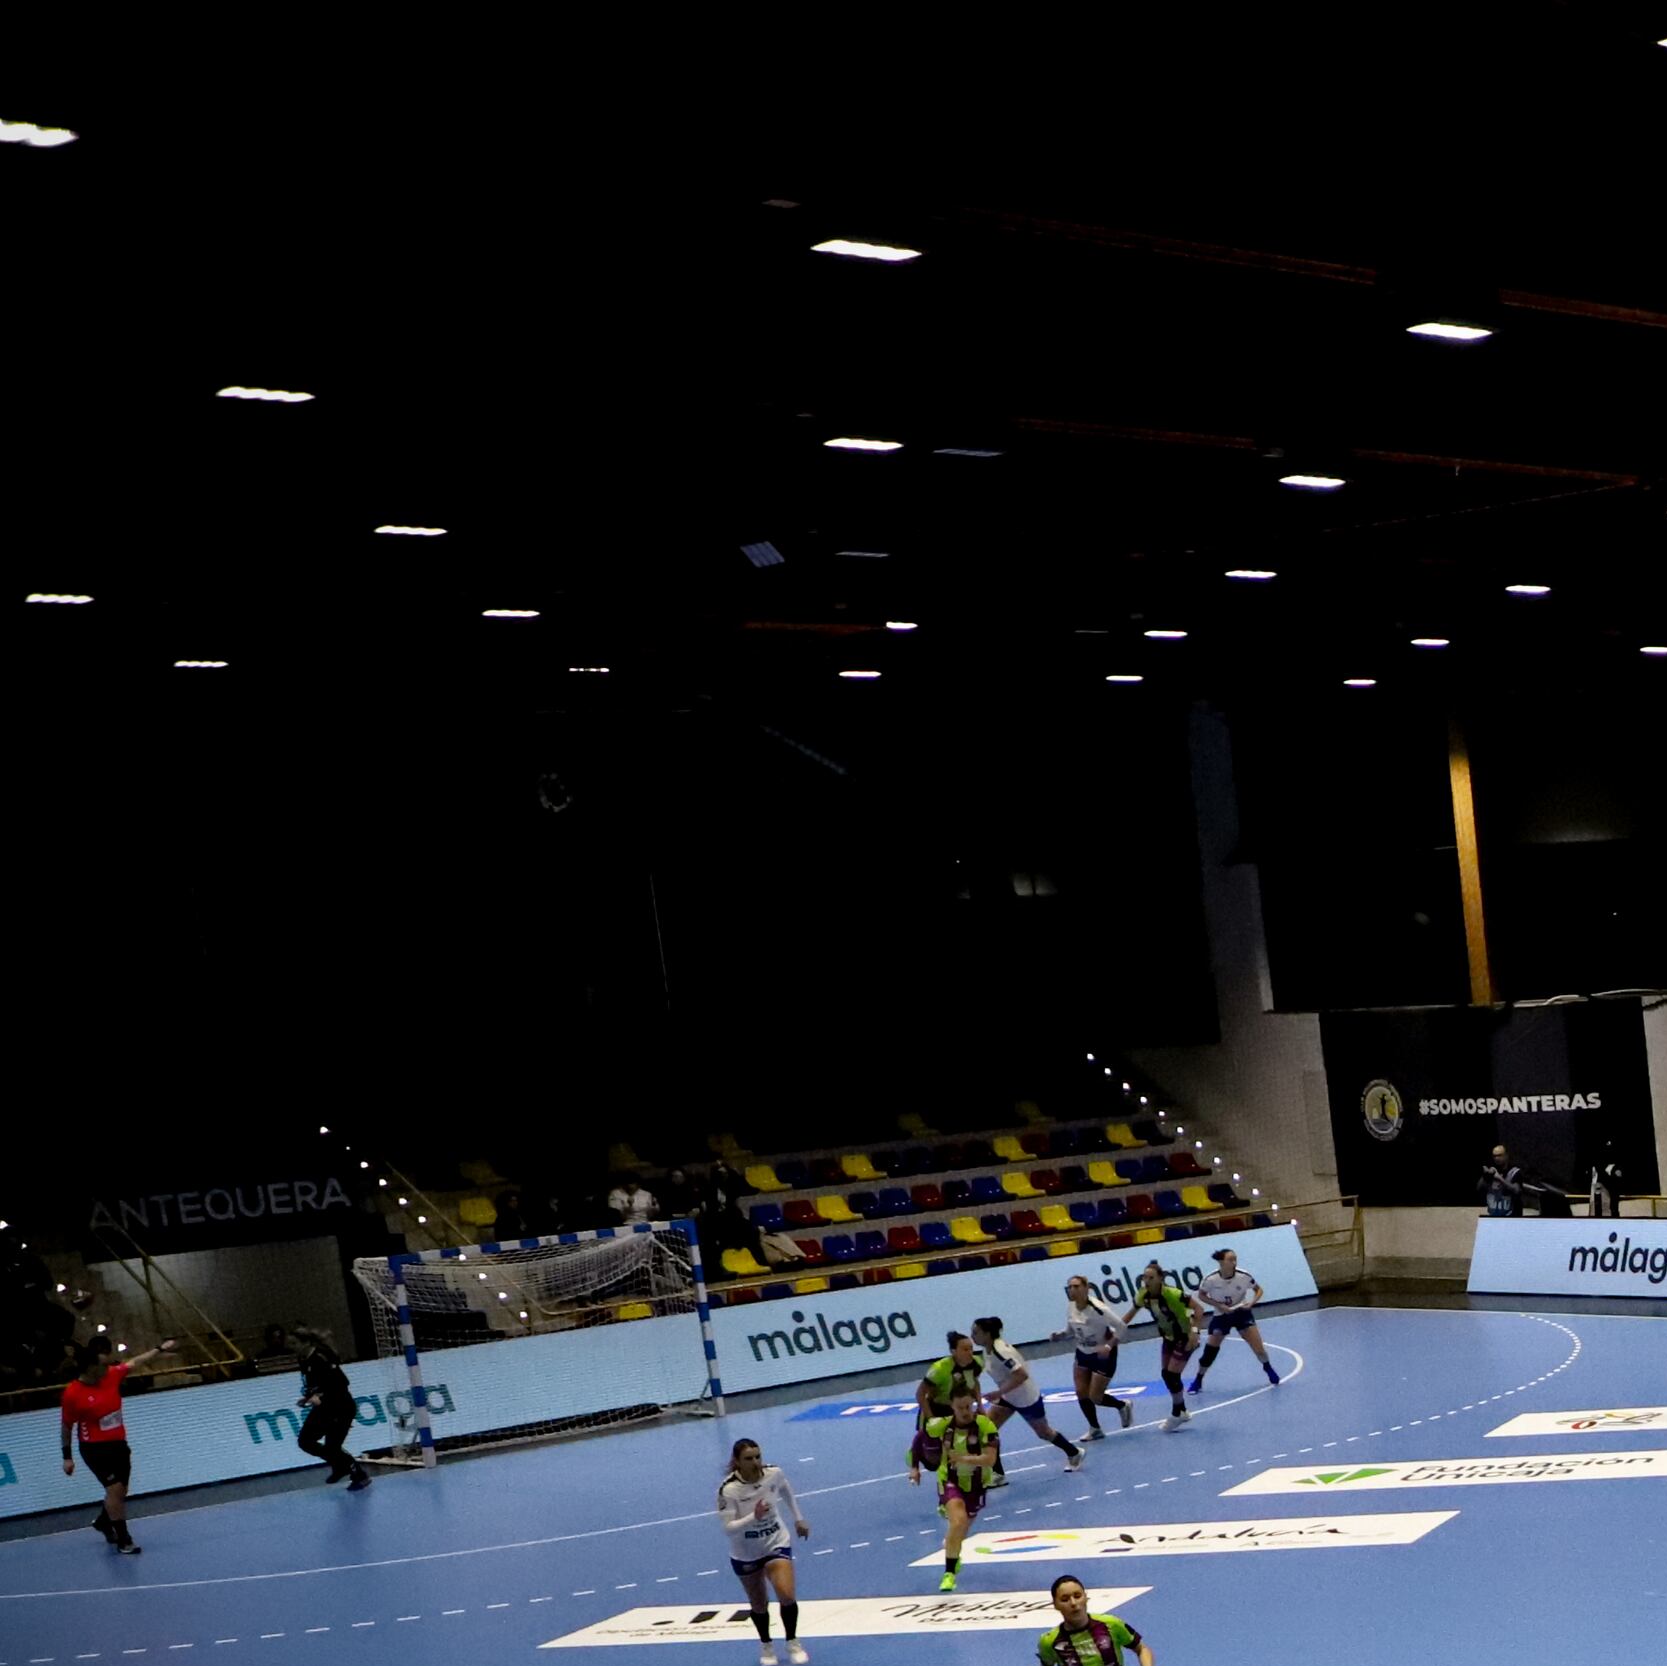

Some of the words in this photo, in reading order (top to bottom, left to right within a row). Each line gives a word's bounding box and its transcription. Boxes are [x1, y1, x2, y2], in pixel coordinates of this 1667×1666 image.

[1419, 1092, 1602, 1117] #SOMOSPANTERAS
[89, 1176, 352, 1231] ANTEQUERA
[1401, 1467, 1574, 1482] Unicaja
[1413, 1457, 1655, 1473] Fundación
[881, 1598, 1054, 1618] Málag
